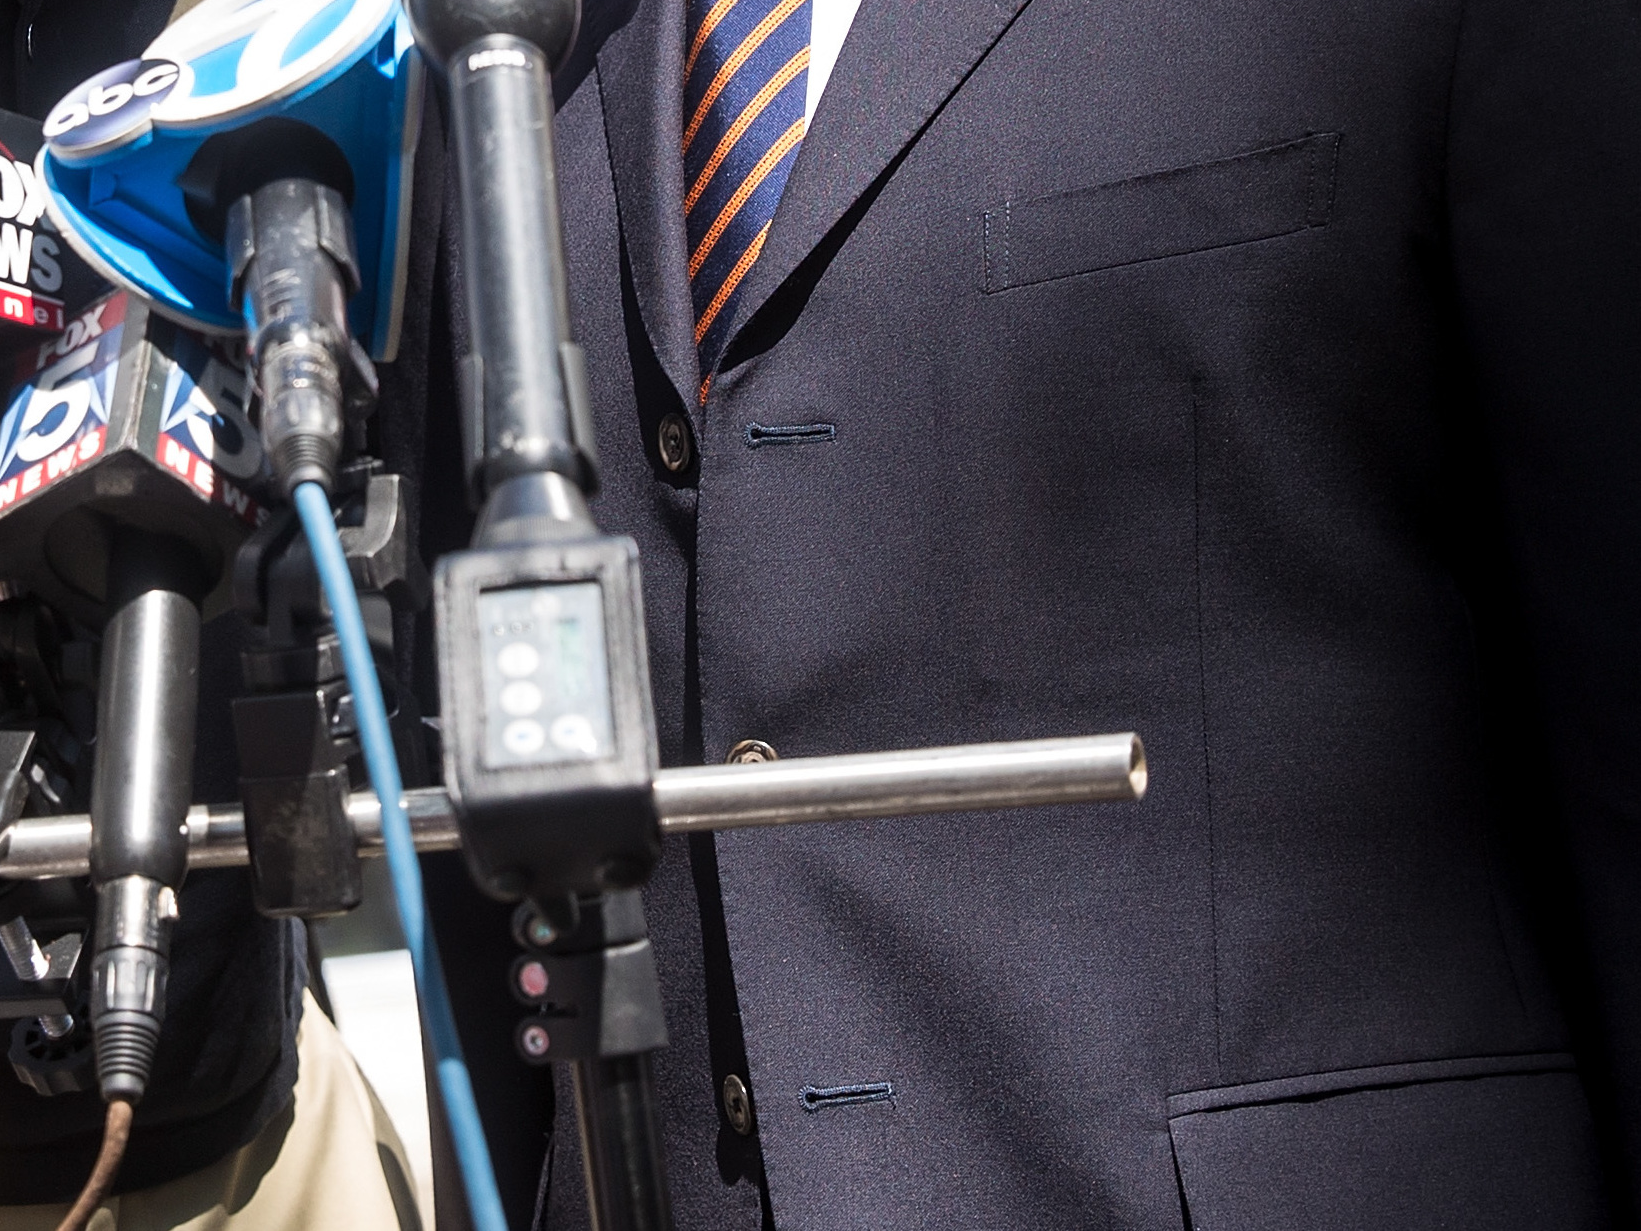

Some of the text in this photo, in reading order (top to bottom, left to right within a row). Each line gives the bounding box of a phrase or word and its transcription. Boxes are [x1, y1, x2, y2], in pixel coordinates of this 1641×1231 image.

[46, 62, 180, 132] abc
[36, 302, 108, 371] FOX
[16, 340, 100, 463] 5
[186, 357, 263, 480] 5
